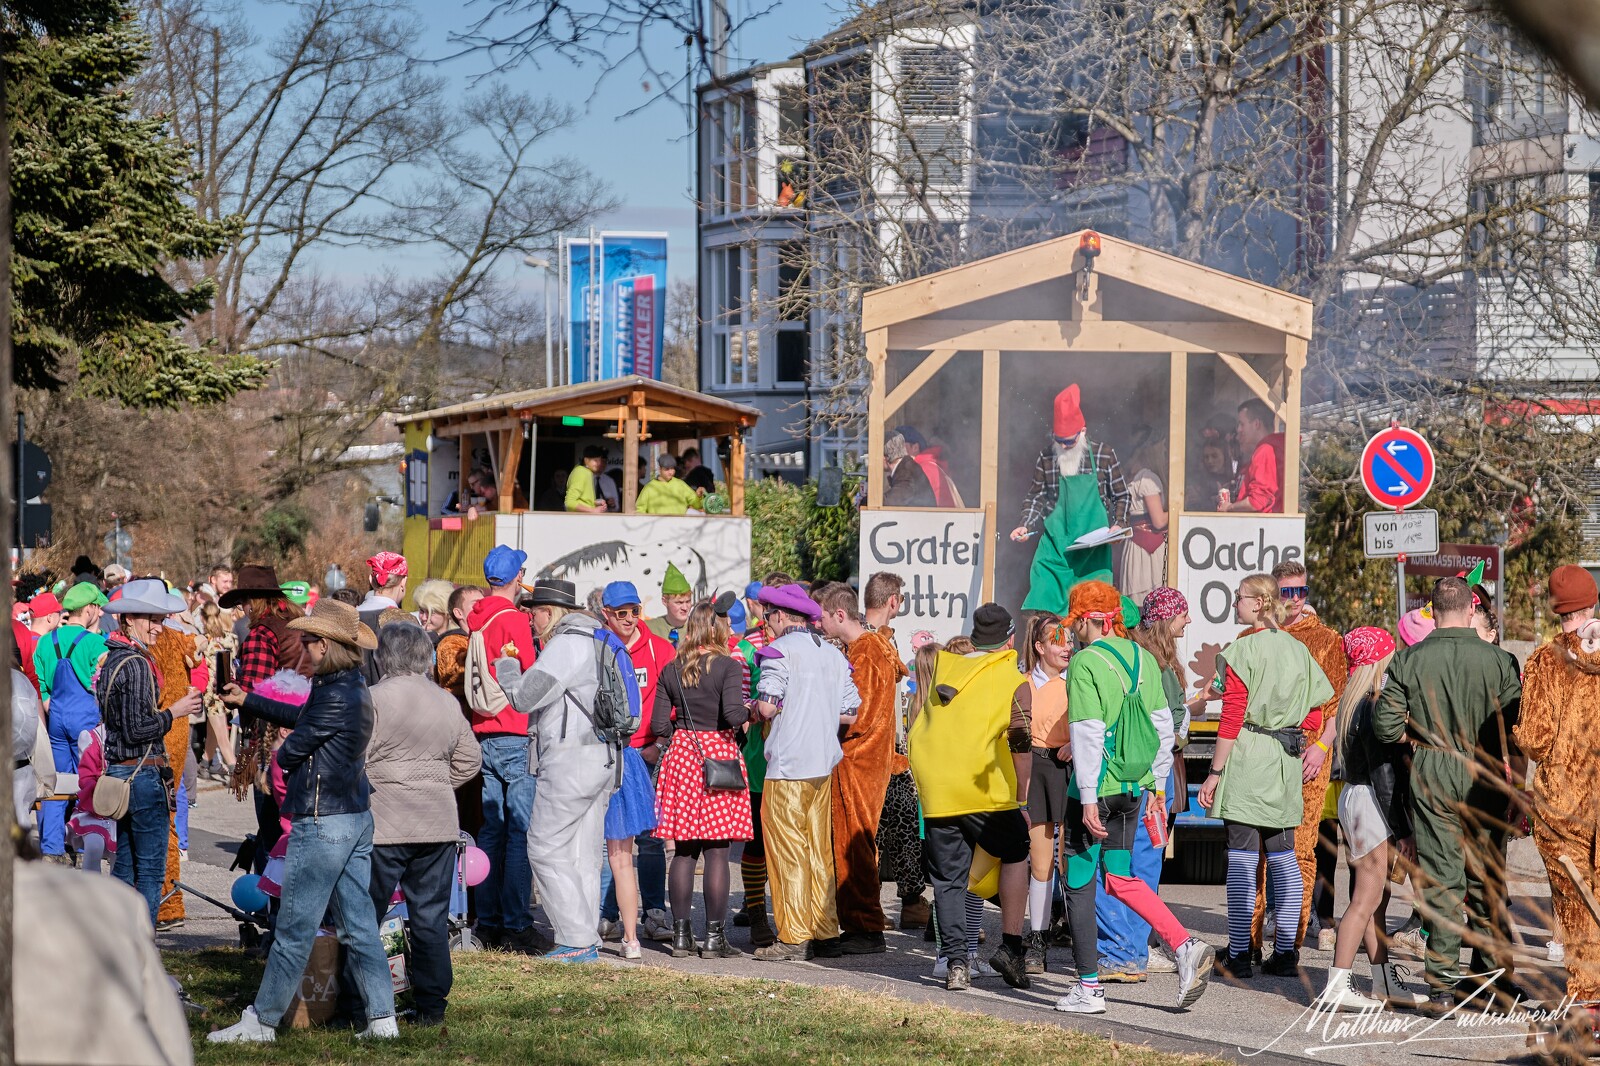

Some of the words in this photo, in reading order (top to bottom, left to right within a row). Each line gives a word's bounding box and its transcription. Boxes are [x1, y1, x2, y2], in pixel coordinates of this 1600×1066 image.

[1374, 522, 1398, 532] von
[869, 521, 980, 566] Grafei
[1182, 526, 1301, 572] Oache
[1374, 536, 1394, 549] bis
[1486, 556, 1492, 570] 9
[297, 974, 340, 1002] C&A
